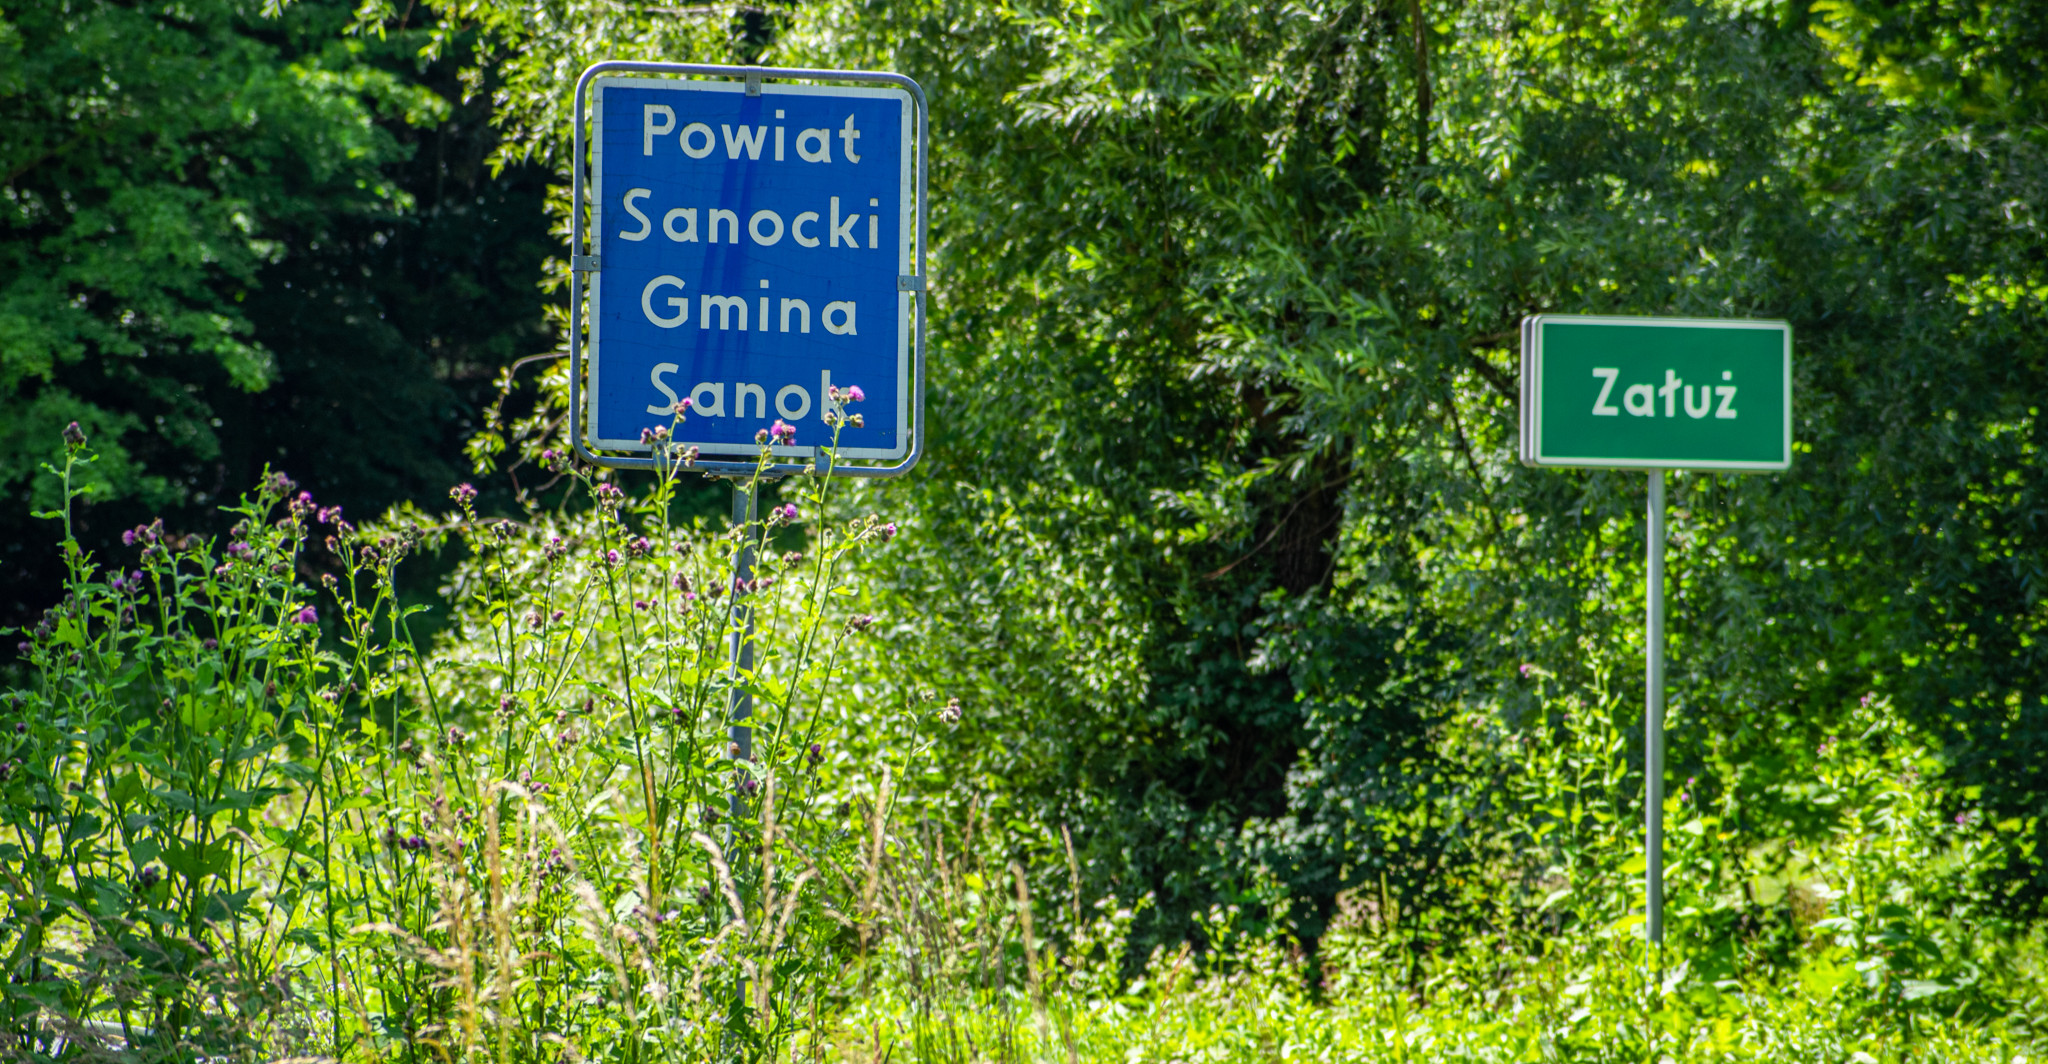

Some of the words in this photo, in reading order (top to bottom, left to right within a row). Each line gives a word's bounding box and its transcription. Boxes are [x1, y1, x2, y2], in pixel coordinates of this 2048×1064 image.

[643, 104, 861, 164] Powiat
[619, 188, 879, 249] Sanocki
[641, 275, 857, 336] Gmina
[1592, 367, 1738, 419] Załuż
